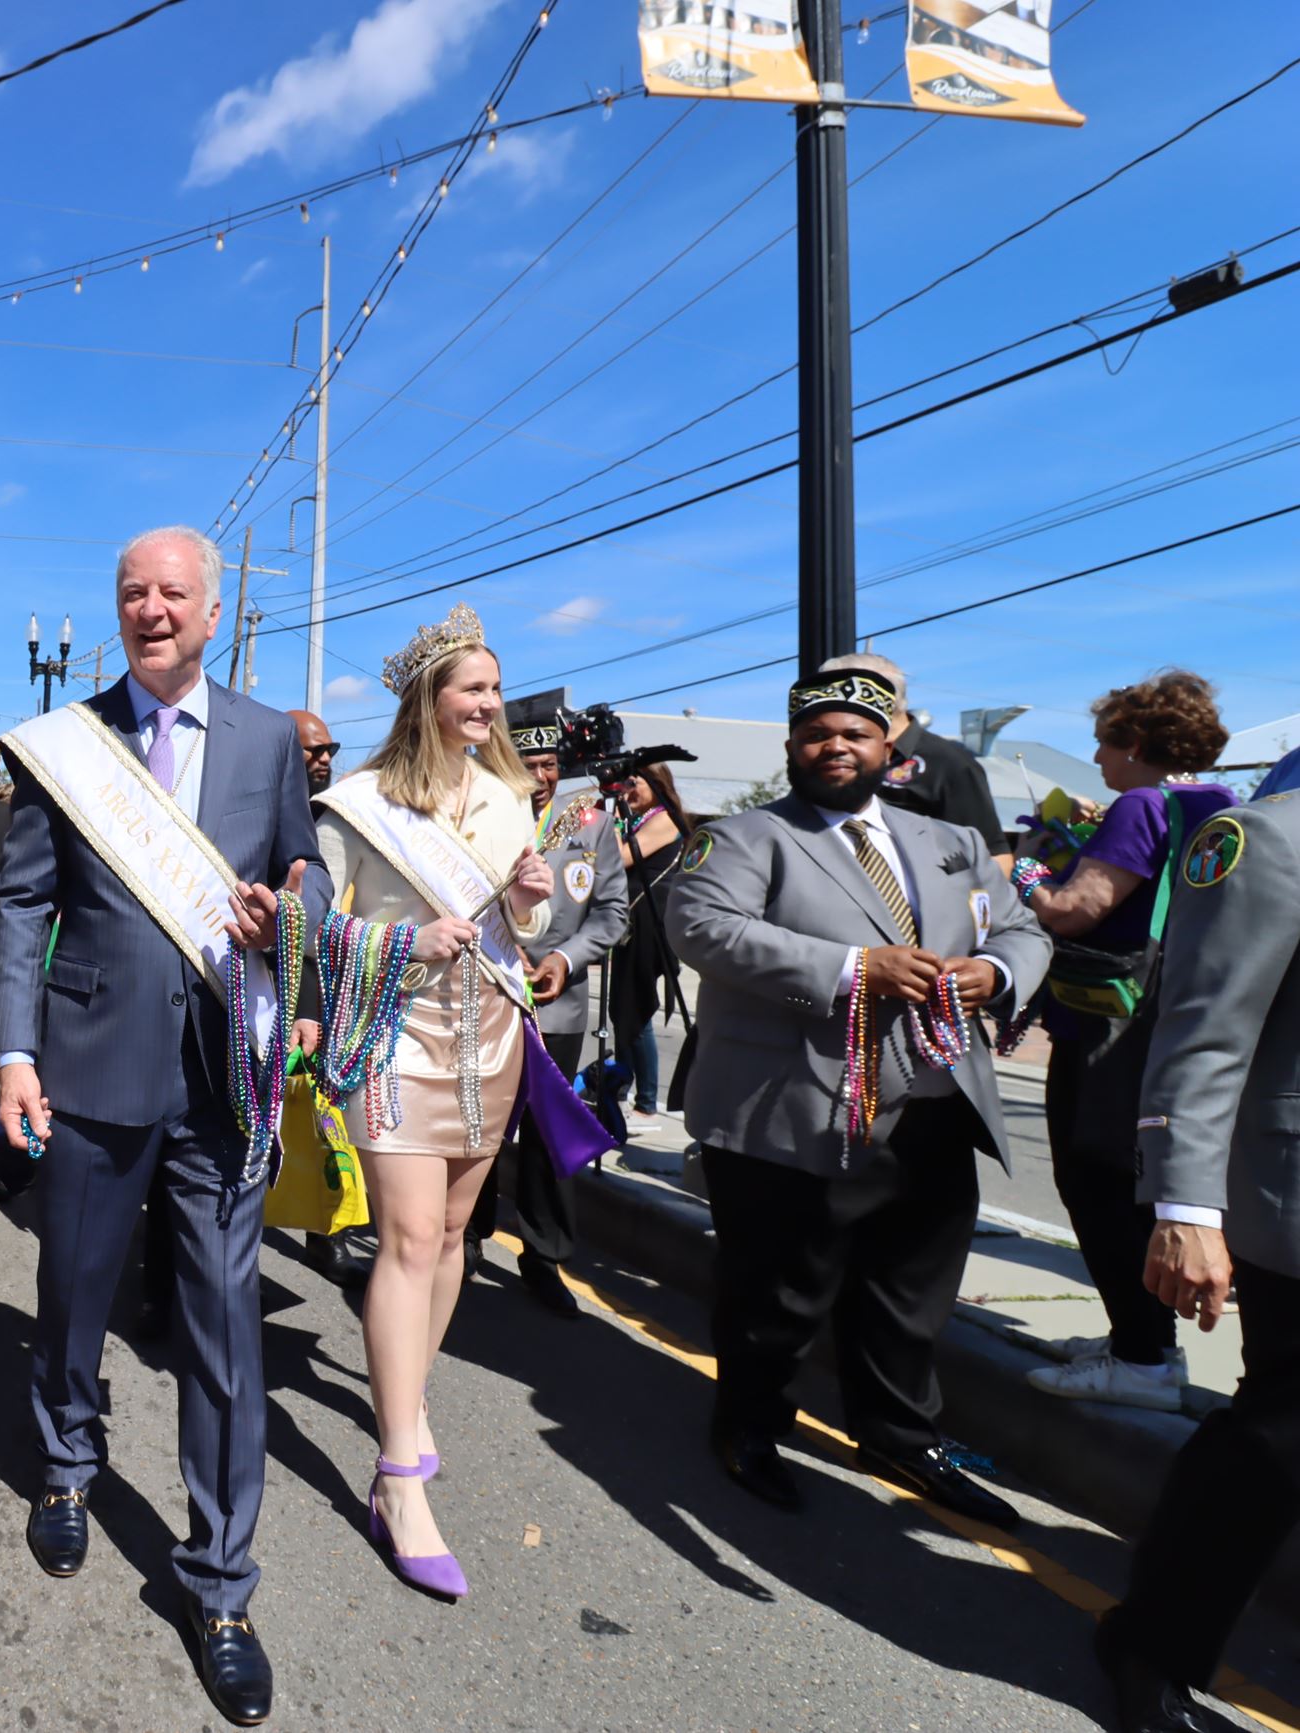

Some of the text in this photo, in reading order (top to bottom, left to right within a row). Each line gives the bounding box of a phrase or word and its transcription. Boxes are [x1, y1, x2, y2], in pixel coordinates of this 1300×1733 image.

[93, 782, 156, 848] ARGUS
[411, 829, 462, 881] QUEEN
[458, 879, 498, 928] ARGS
